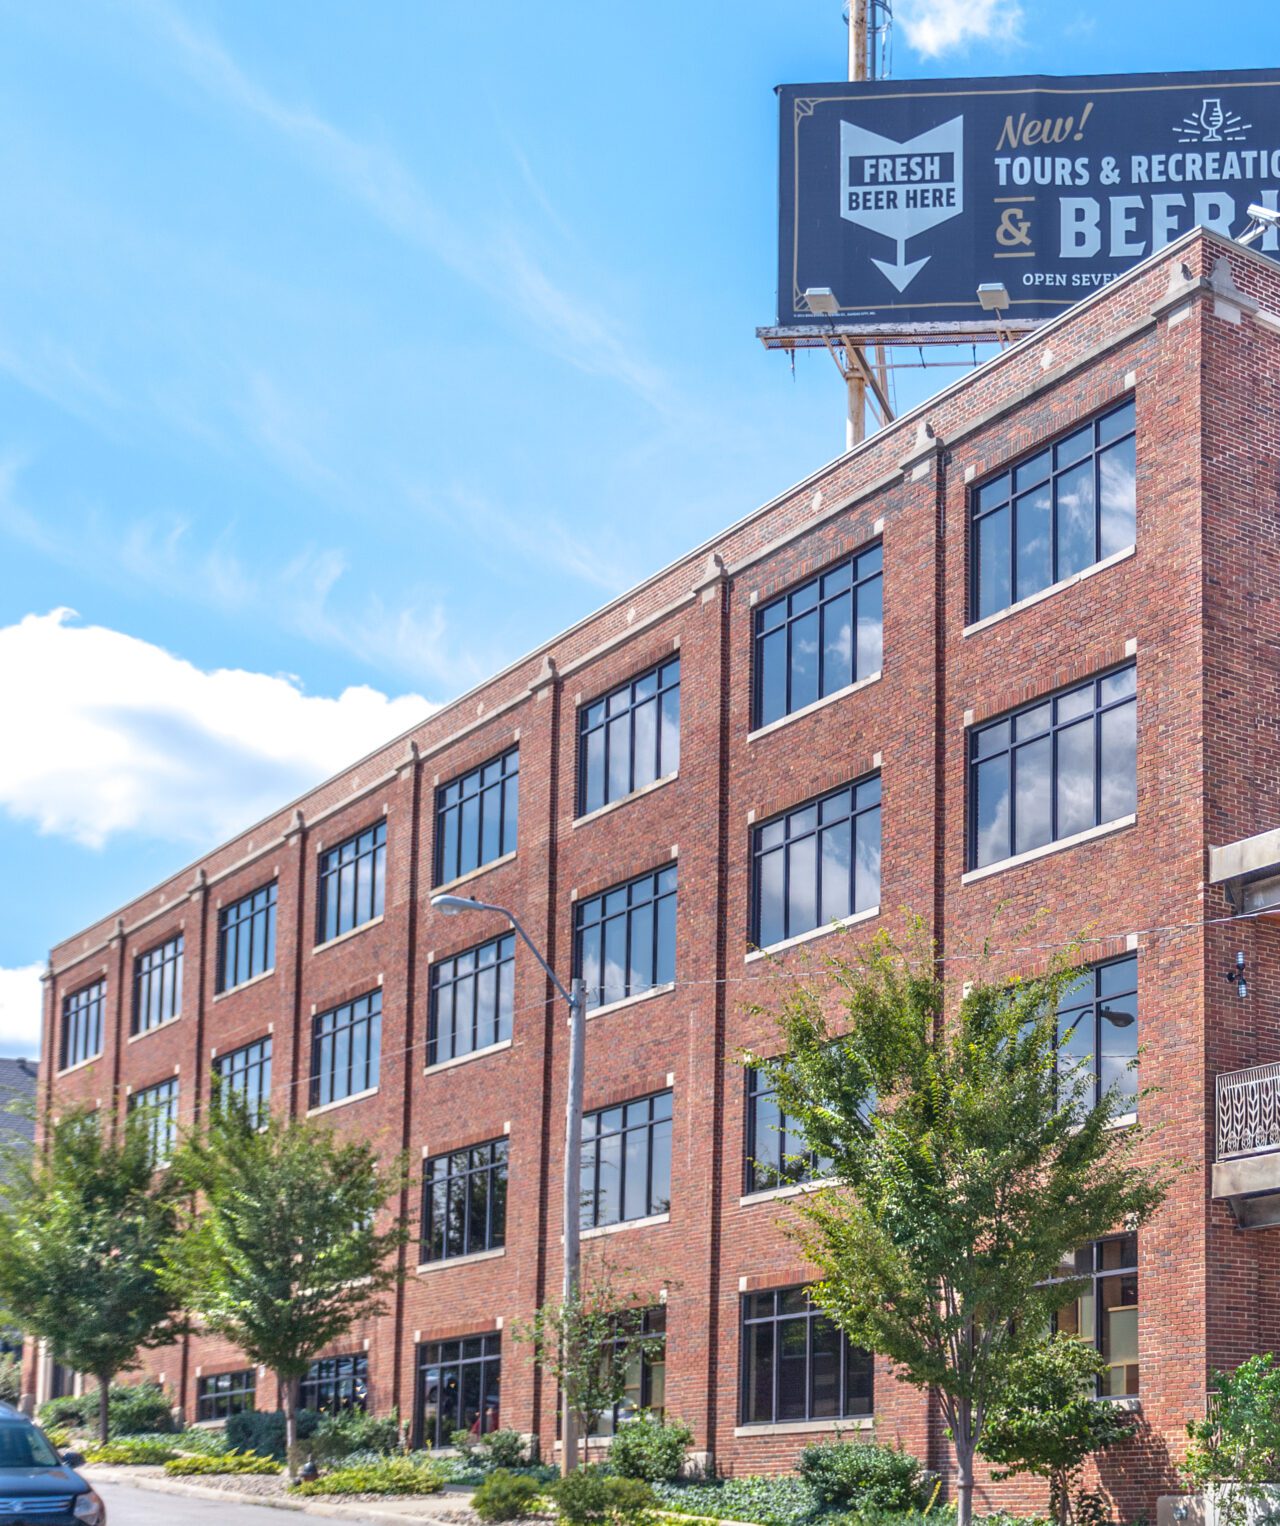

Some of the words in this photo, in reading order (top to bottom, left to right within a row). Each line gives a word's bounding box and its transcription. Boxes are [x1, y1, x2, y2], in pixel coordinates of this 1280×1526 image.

[996, 102, 1094, 151] New!
[863, 155, 941, 183] FRESH
[994, 156, 1090, 186] TOURS
[1099, 156, 1121, 185] &
[848, 190, 899, 211] BEER
[905, 187, 957, 209] HERE
[996, 208, 1032, 246] &
[1059, 191, 1236, 258] BEER
[1022, 273, 1067, 286] OPEN
